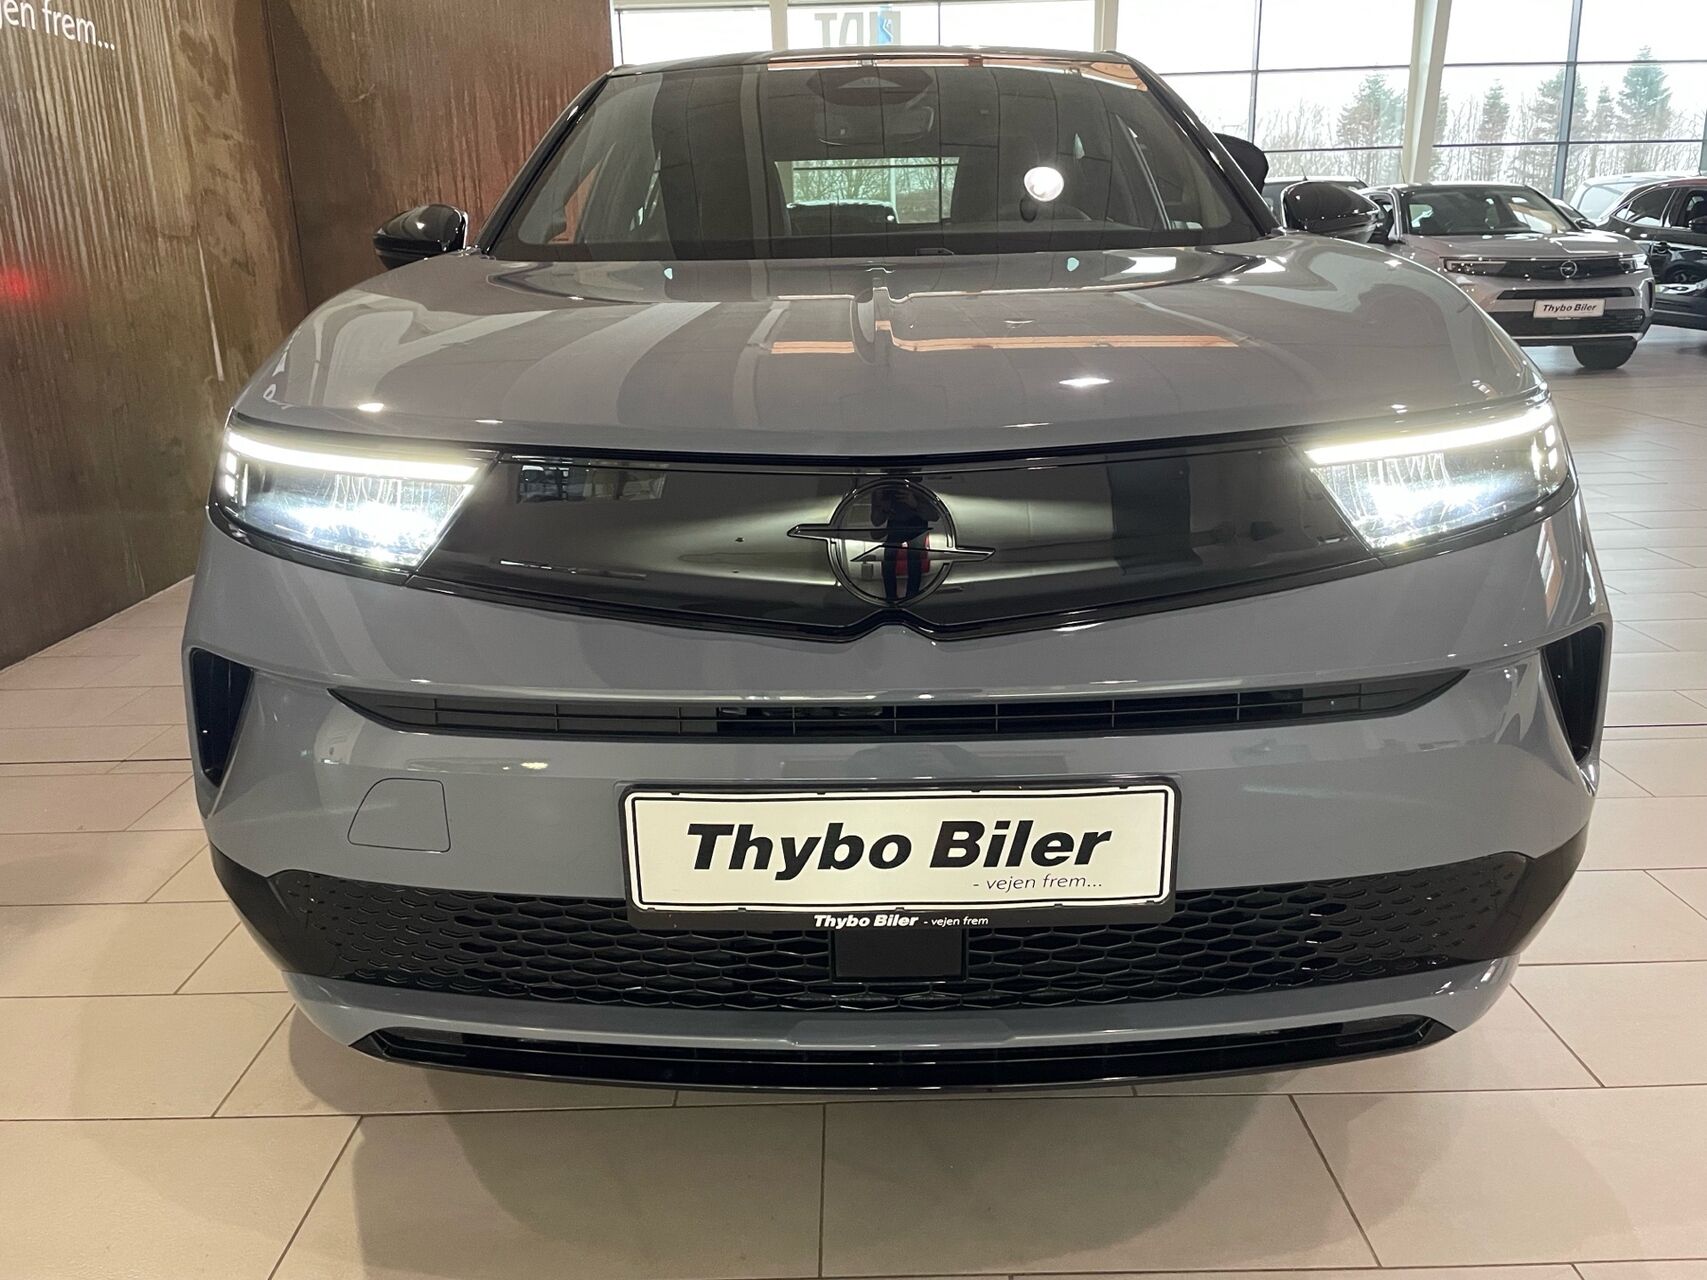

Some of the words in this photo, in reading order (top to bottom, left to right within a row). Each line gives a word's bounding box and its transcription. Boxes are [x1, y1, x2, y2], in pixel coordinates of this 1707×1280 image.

[1543, 304, 1573, 313] Thybo
[1574, 303, 1597, 312] Biler
[687, 822, 912, 881] Thybo
[929, 819, 1113, 869] Biler
[986, 875, 1036, 894] vejen
[1042, 872, 1102, 888] frem...
[813, 914, 871, 929] Thybo
[873, 913, 920, 927] Biler
[931, 916, 961, 928] vejen
[962, 915, 989, 926] frem
